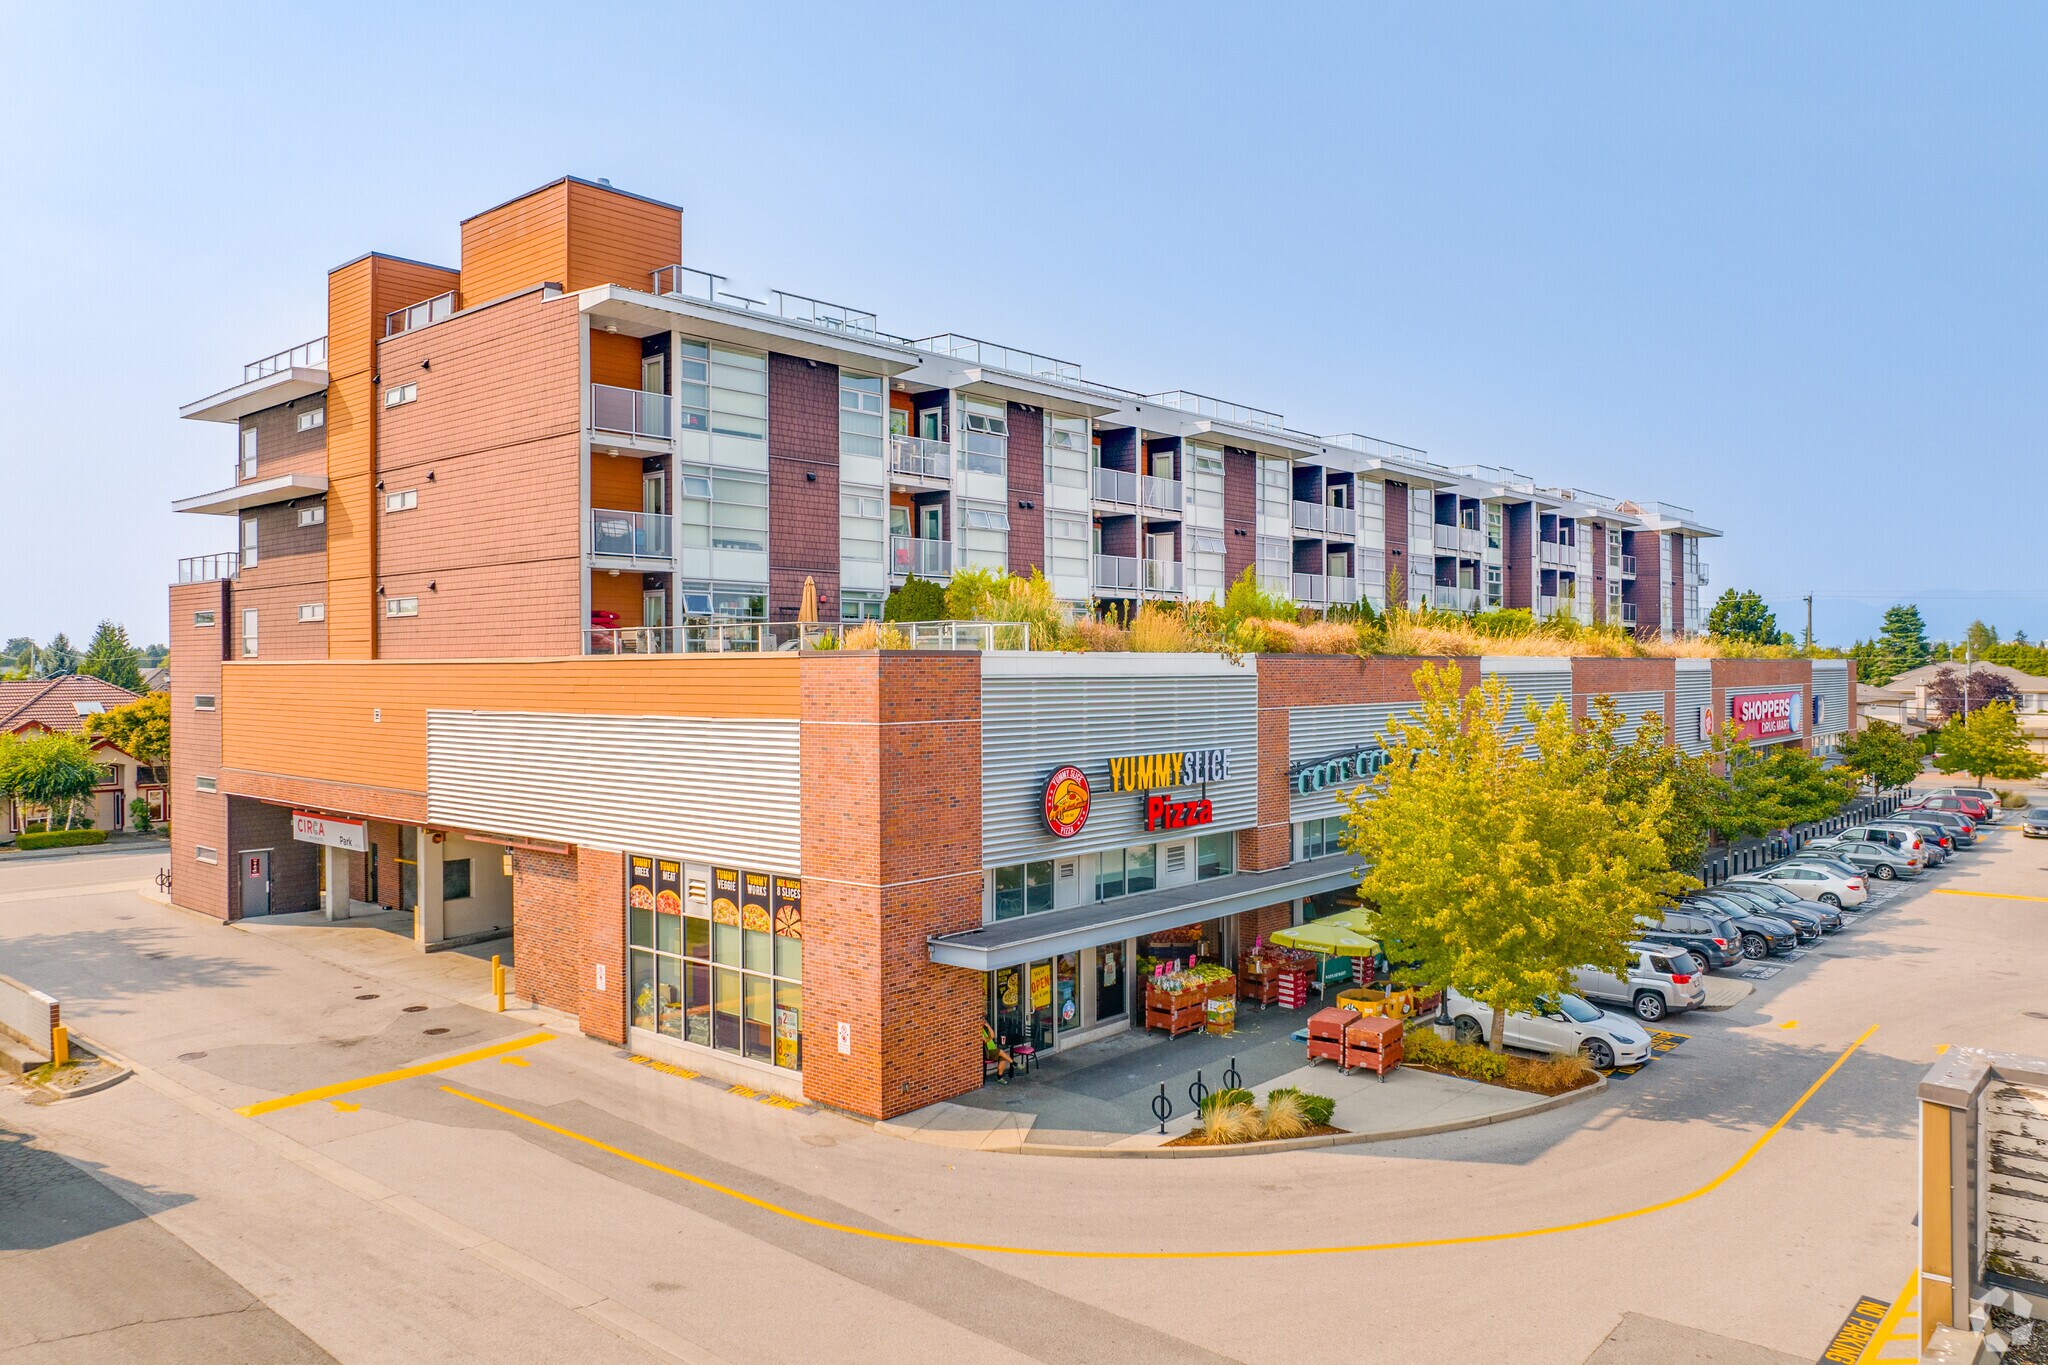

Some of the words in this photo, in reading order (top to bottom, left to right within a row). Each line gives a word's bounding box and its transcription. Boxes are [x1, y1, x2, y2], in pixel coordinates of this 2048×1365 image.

[1742, 698, 1790, 721] SHOPPERS
[1761, 721, 1777, 733] DRUG
[1778, 719, 1790, 731] MART
[1052, 769, 1070, 786] YUMMY
[1070, 769, 1084, 784] SLICE
[1147, 794, 1213, 832] Pizza
[297, 818, 325, 836] CIRCA
[1060, 826, 1074, 835] PIZZA
[339, 835, 353, 847] Park
[633, 857, 652, 869] YUMMY
[660, 861, 679, 873] YUMMY
[716, 869, 737, 882] YUMMY
[746, 874, 768, 887] YUMMY
[717, 879, 736, 892] VEGGIE
[747, 884, 767, 897] WORKS
[776, 886, 781, 896] 8
[781, 886, 801, 899] SLICES
[1031, 974, 1050, 993] OPEN
[626, 1054, 651, 1065] NO
[645, 1061, 701, 1080] PARKING
[727, 1084, 762, 1098] TOW
[758, 1095, 804, 1111] ZONE
[1855, 1299, 1889, 1319] NO
[1824, 1316, 1879, 1365] PARKING
